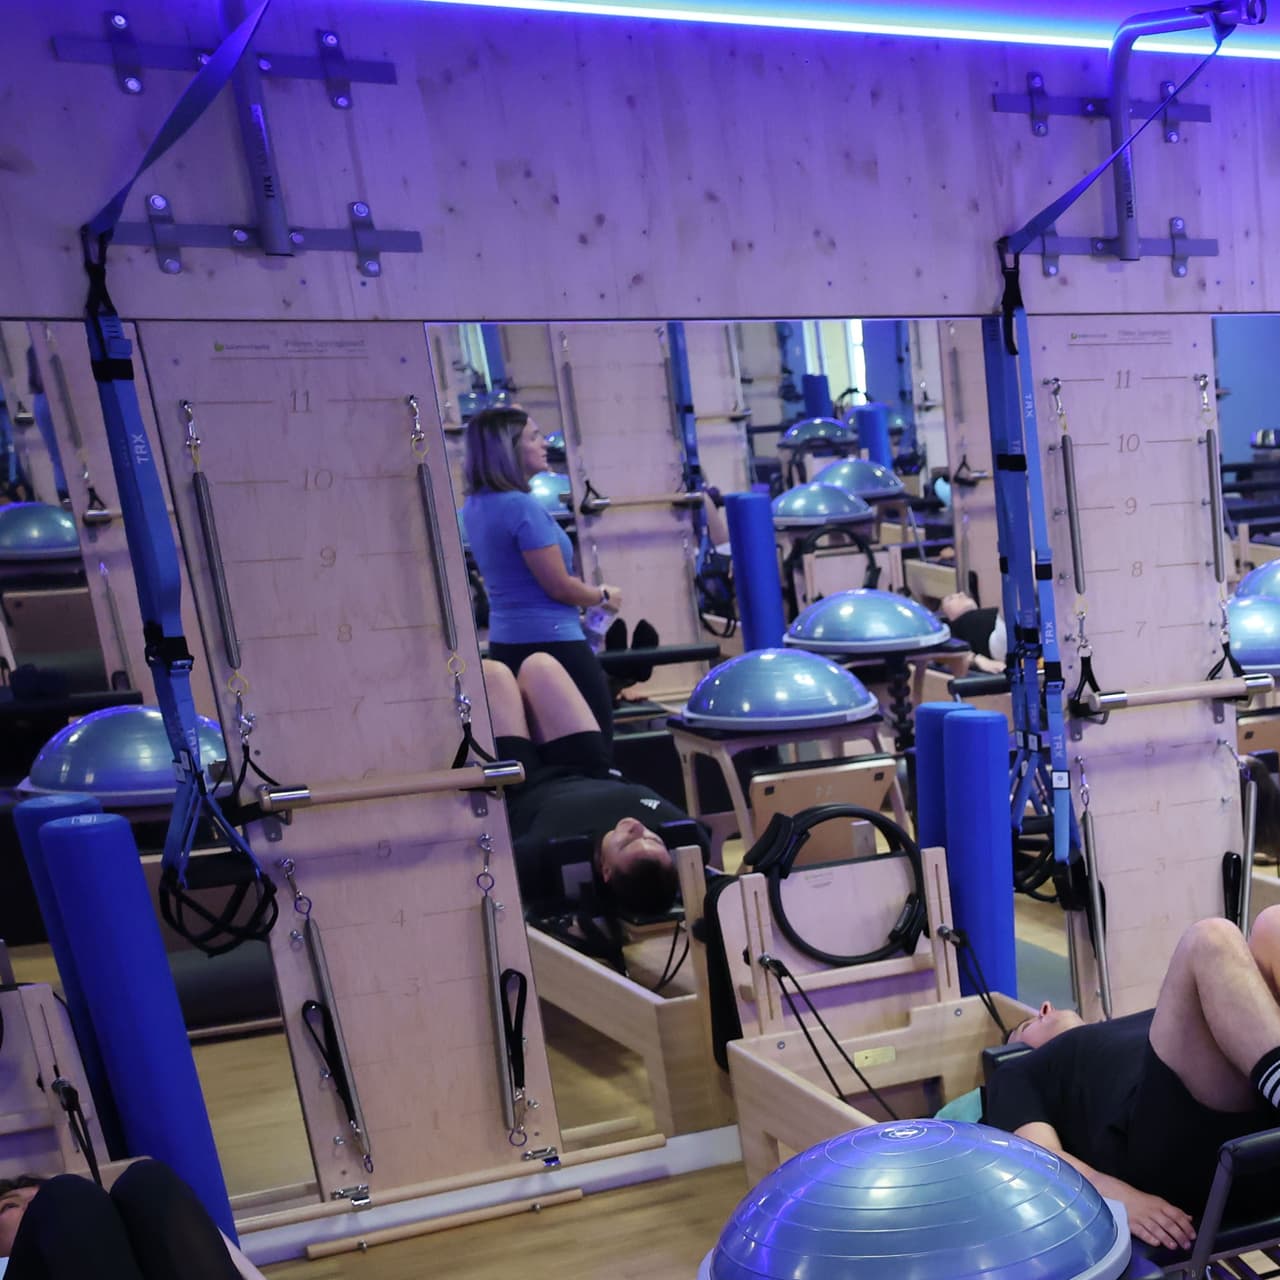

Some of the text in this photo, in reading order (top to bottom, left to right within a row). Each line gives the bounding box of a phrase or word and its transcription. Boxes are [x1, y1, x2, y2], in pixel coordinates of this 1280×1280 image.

[1114, 369, 1131, 389] 11
[289, 389, 313, 413] 11
[131, 433, 150, 464] TRX
[1118, 433, 1141, 453] 10
[1125, 496, 1137, 515] 9
[320, 546, 337, 568] 9
